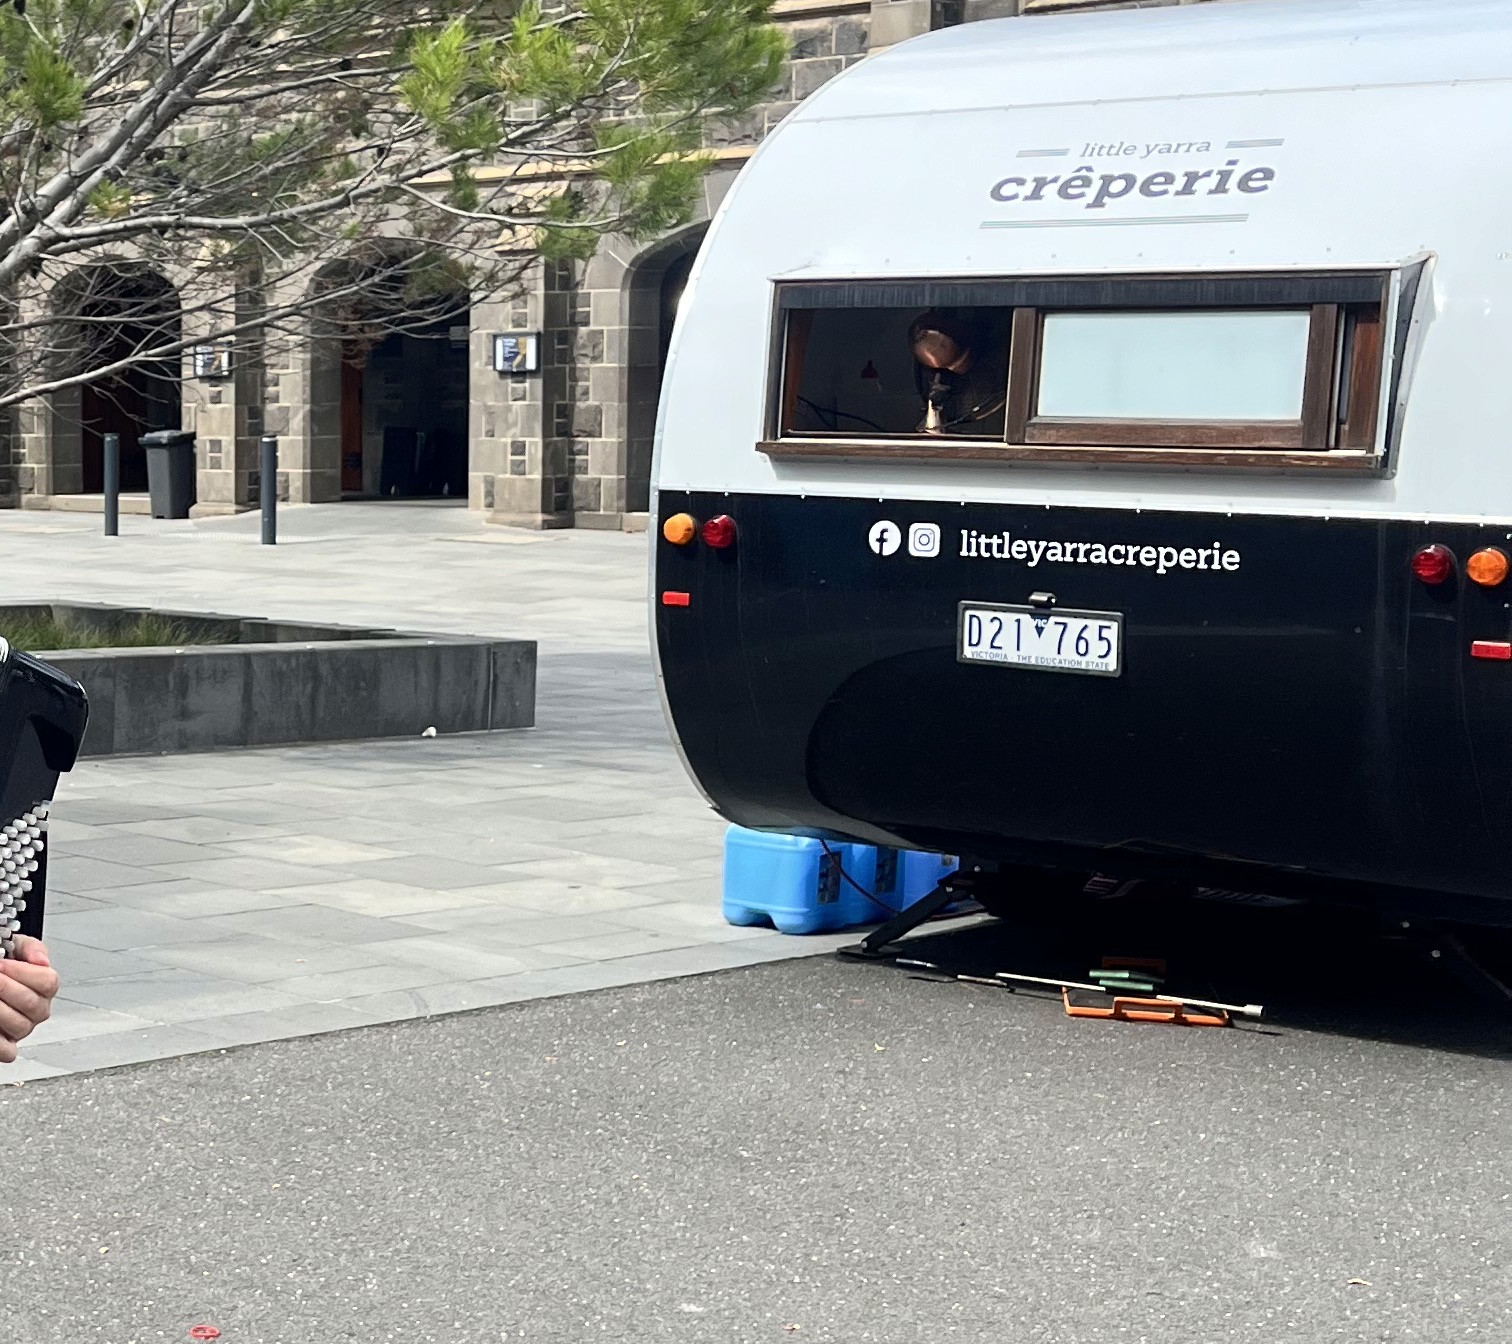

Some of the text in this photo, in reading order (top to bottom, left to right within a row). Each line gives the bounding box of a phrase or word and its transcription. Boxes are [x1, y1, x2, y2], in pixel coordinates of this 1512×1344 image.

[1079, 139, 1212, 159] little yarra
[989, 158, 1276, 209] crêperie
[959, 529, 1241, 574] littleyarracreperie
[970, 650, 1110, 670] VICTORIA THE EDUCATION STATE
